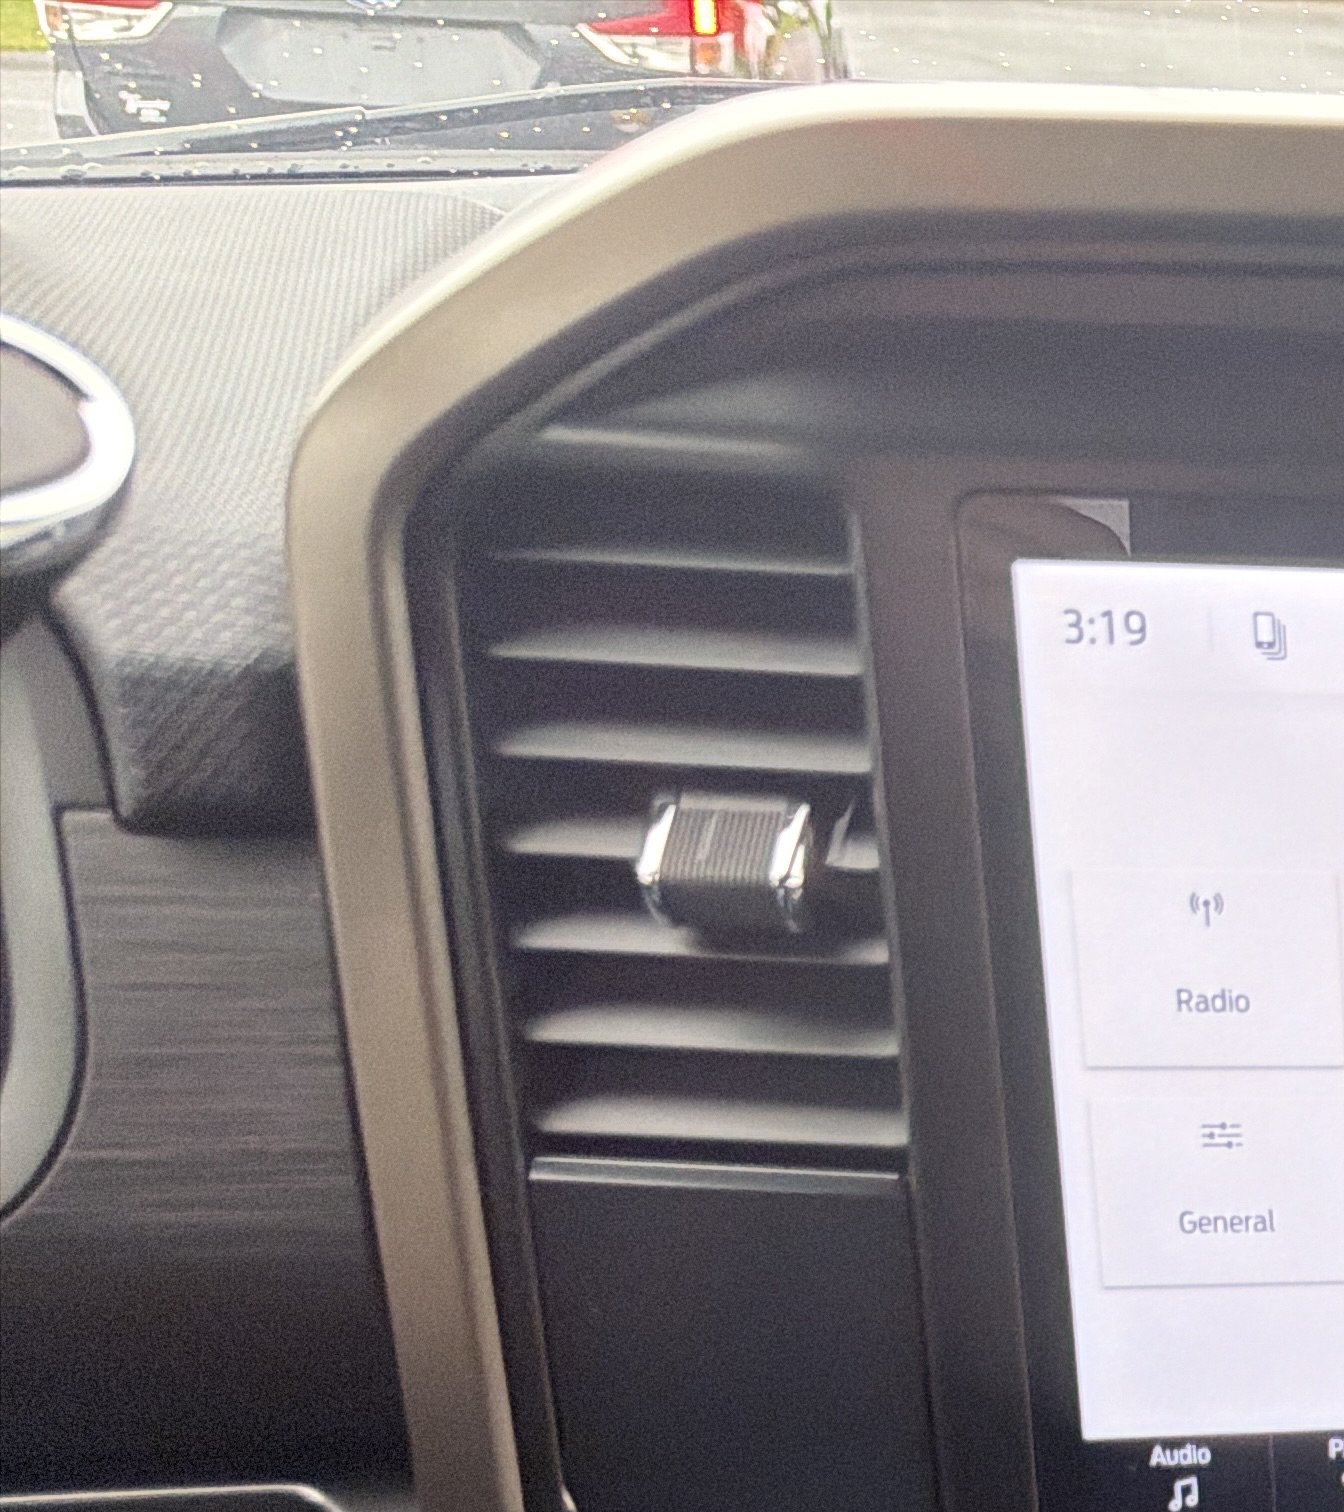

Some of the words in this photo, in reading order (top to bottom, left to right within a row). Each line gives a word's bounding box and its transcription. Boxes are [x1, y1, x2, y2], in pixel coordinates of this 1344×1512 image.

[1062, 608, 1148, 646] 3:19
[1176, 988, 1250, 1014] Radio
[1178, 1208, 1275, 1234] General
[1150, 1442, 1211, 1468] Audio
